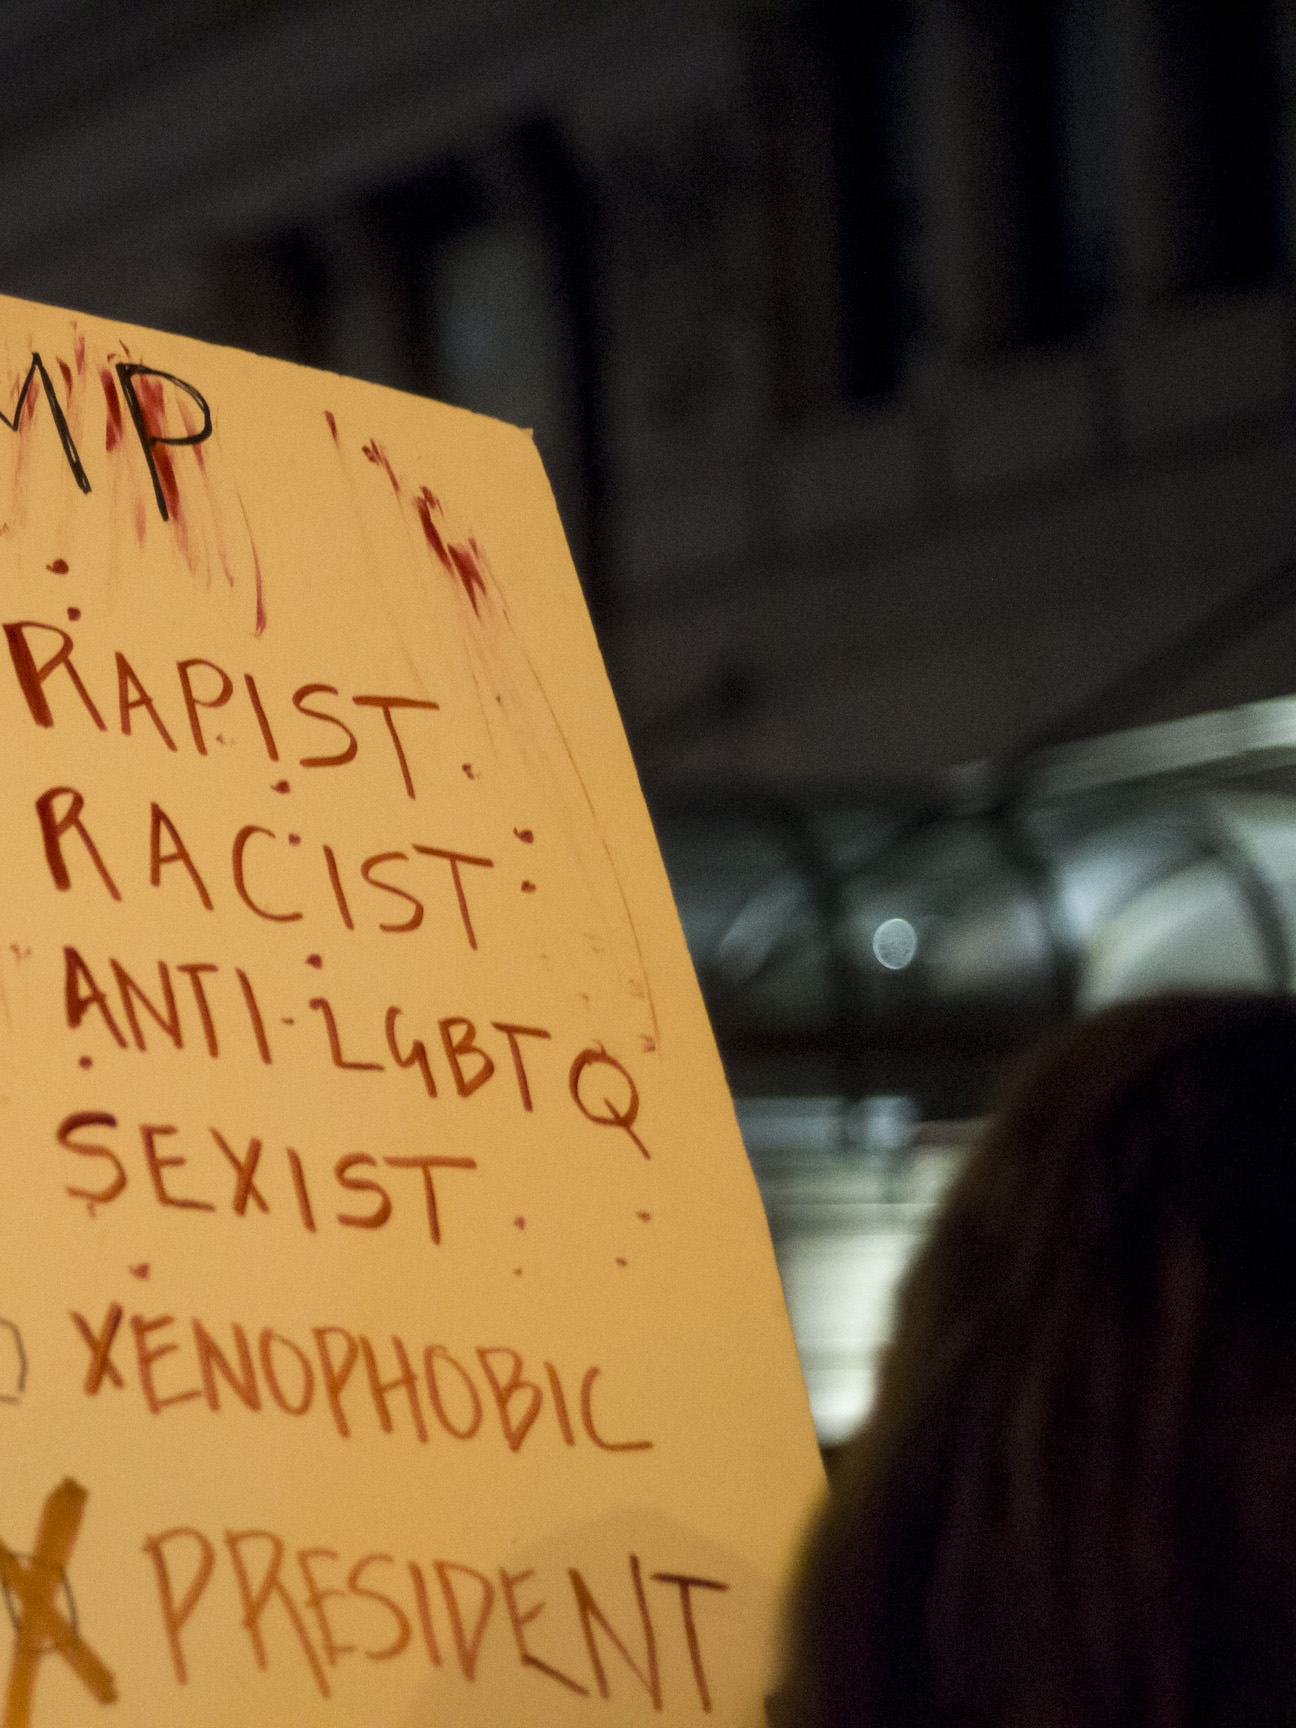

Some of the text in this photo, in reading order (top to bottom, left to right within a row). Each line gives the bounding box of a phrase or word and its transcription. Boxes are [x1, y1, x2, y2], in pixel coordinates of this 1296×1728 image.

[3, 620, 440, 800] RAPIST
[34, 785, 494, 950] RACIST
[63, 945, 651, 1161] ANTI-LGBTQ
[55, 1110, 478, 1246] SEXIST
[68, 1301, 654, 1453] XENOPHOBIC
[141, 1526, 731, 1713] PRESIDENT
